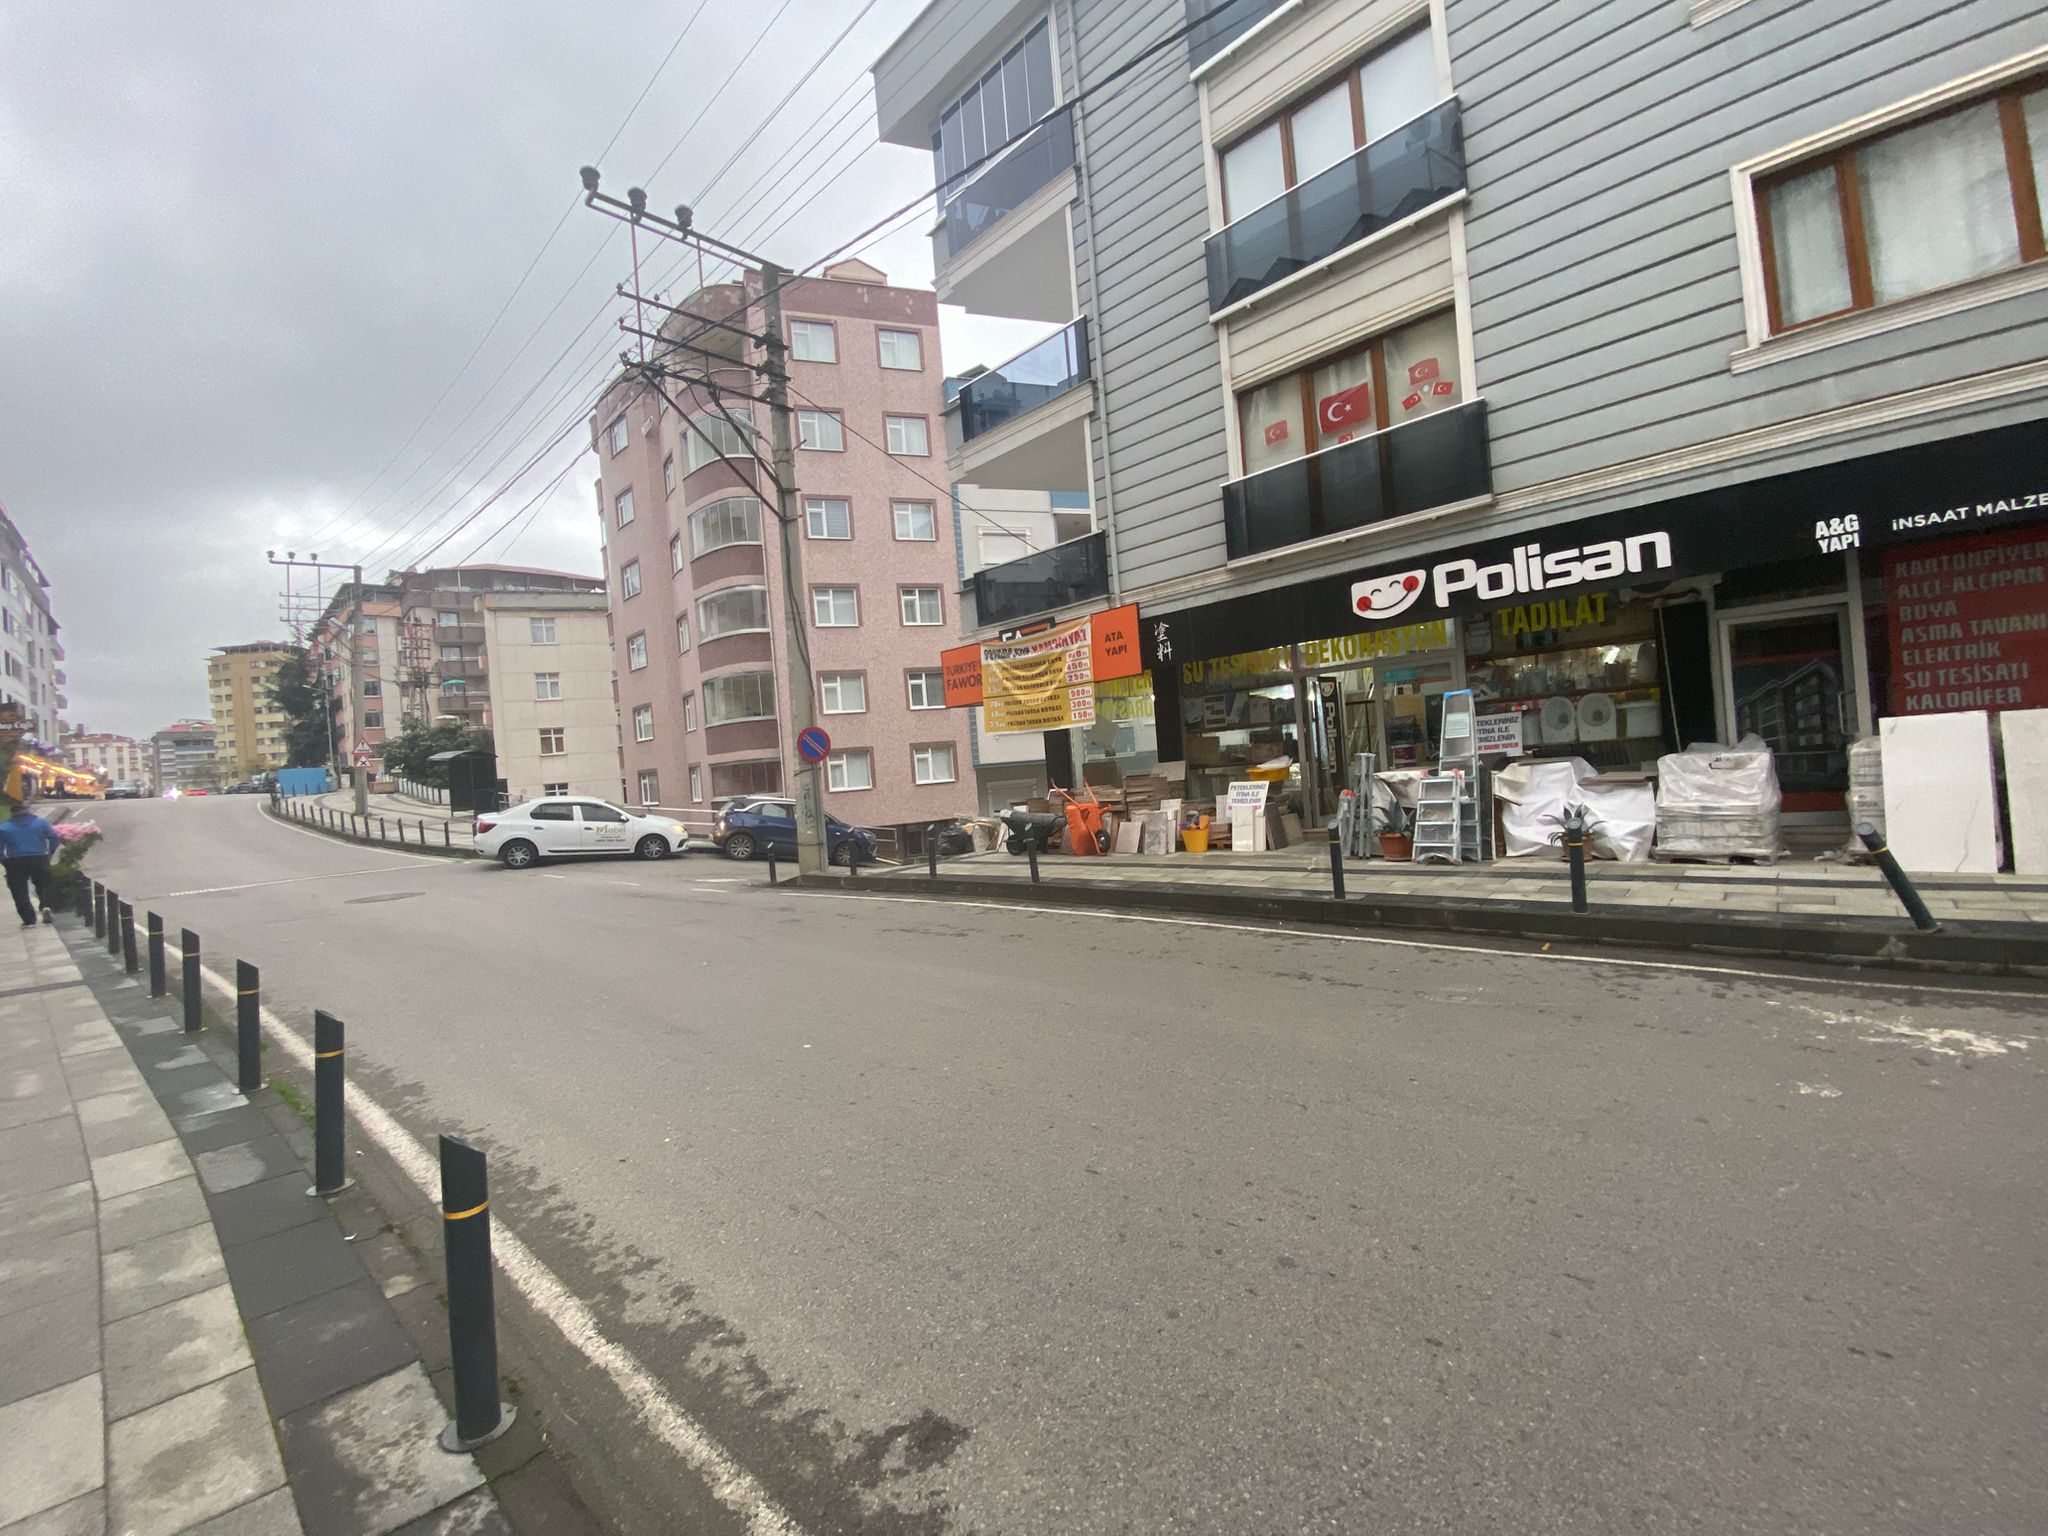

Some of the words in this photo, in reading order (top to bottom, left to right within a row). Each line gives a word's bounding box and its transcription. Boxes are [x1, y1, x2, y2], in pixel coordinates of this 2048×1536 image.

[1815, 513, 1860, 539] A&G
[1817, 532, 1860, 554] YAPI
[1432, 531, 1673, 609] Polisan
[1899, 600, 1958, 621] BOYA
[1104, 630, 1123, 643] ATA
[1901, 622, 1964, 644] ASMA
[1104, 645, 1127, 657] YAPI
[1182, 661, 1204, 685] SU
[1903, 670, 1931, 689] SU
[1905, 686, 2022, 711] KALORİFER
